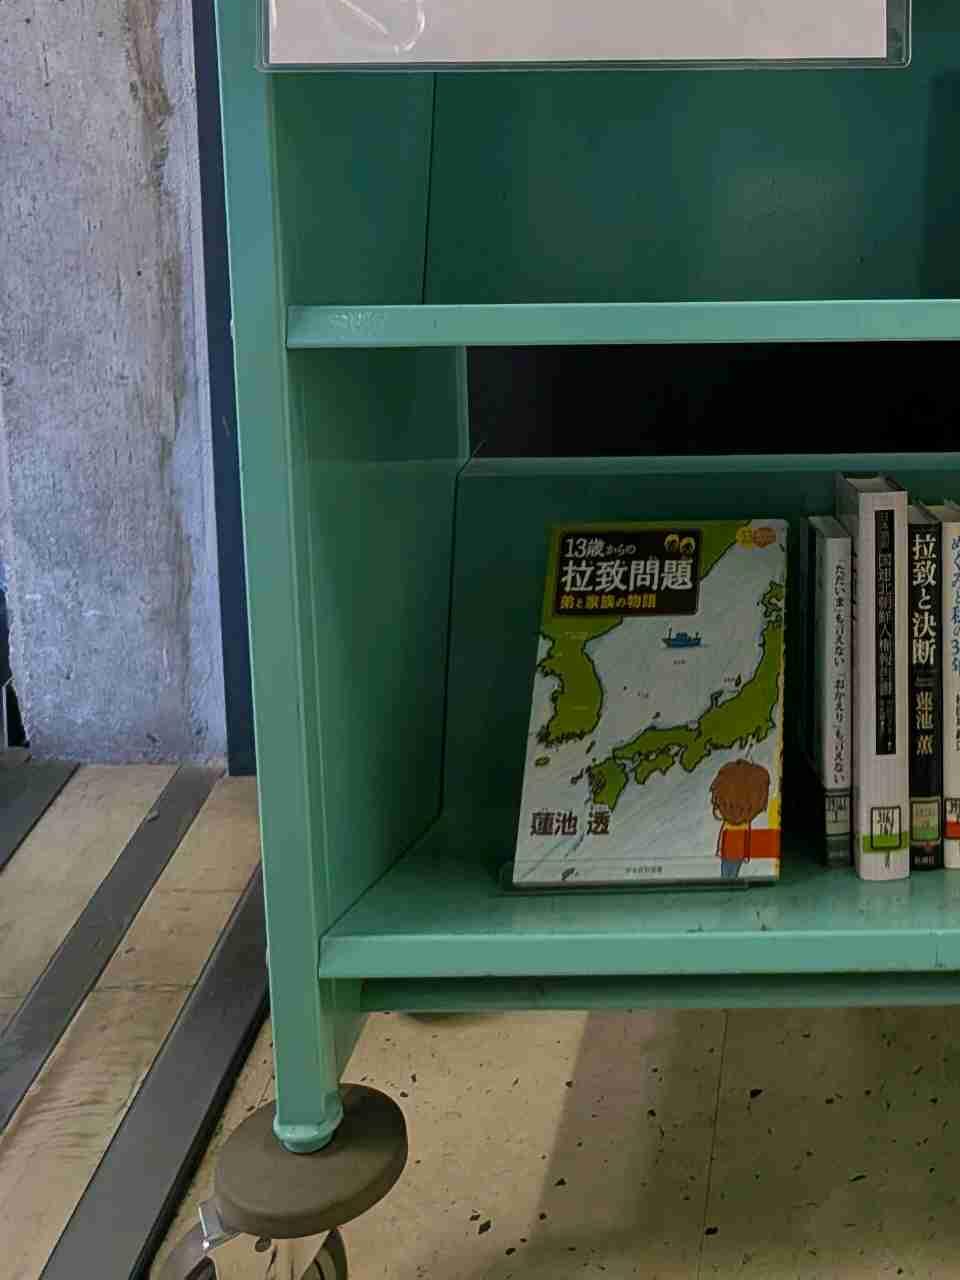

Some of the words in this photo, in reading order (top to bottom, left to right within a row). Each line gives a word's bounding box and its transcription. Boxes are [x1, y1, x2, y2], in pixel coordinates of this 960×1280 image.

[565, 537, 637, 560] 13歳からの
[561, 559, 695, 593] 拉致問題
[911, 532, 938, 667] 拉致と決断
[530, 810, 577, 836] 蓮池
[587, 810, 611, 836] 透
